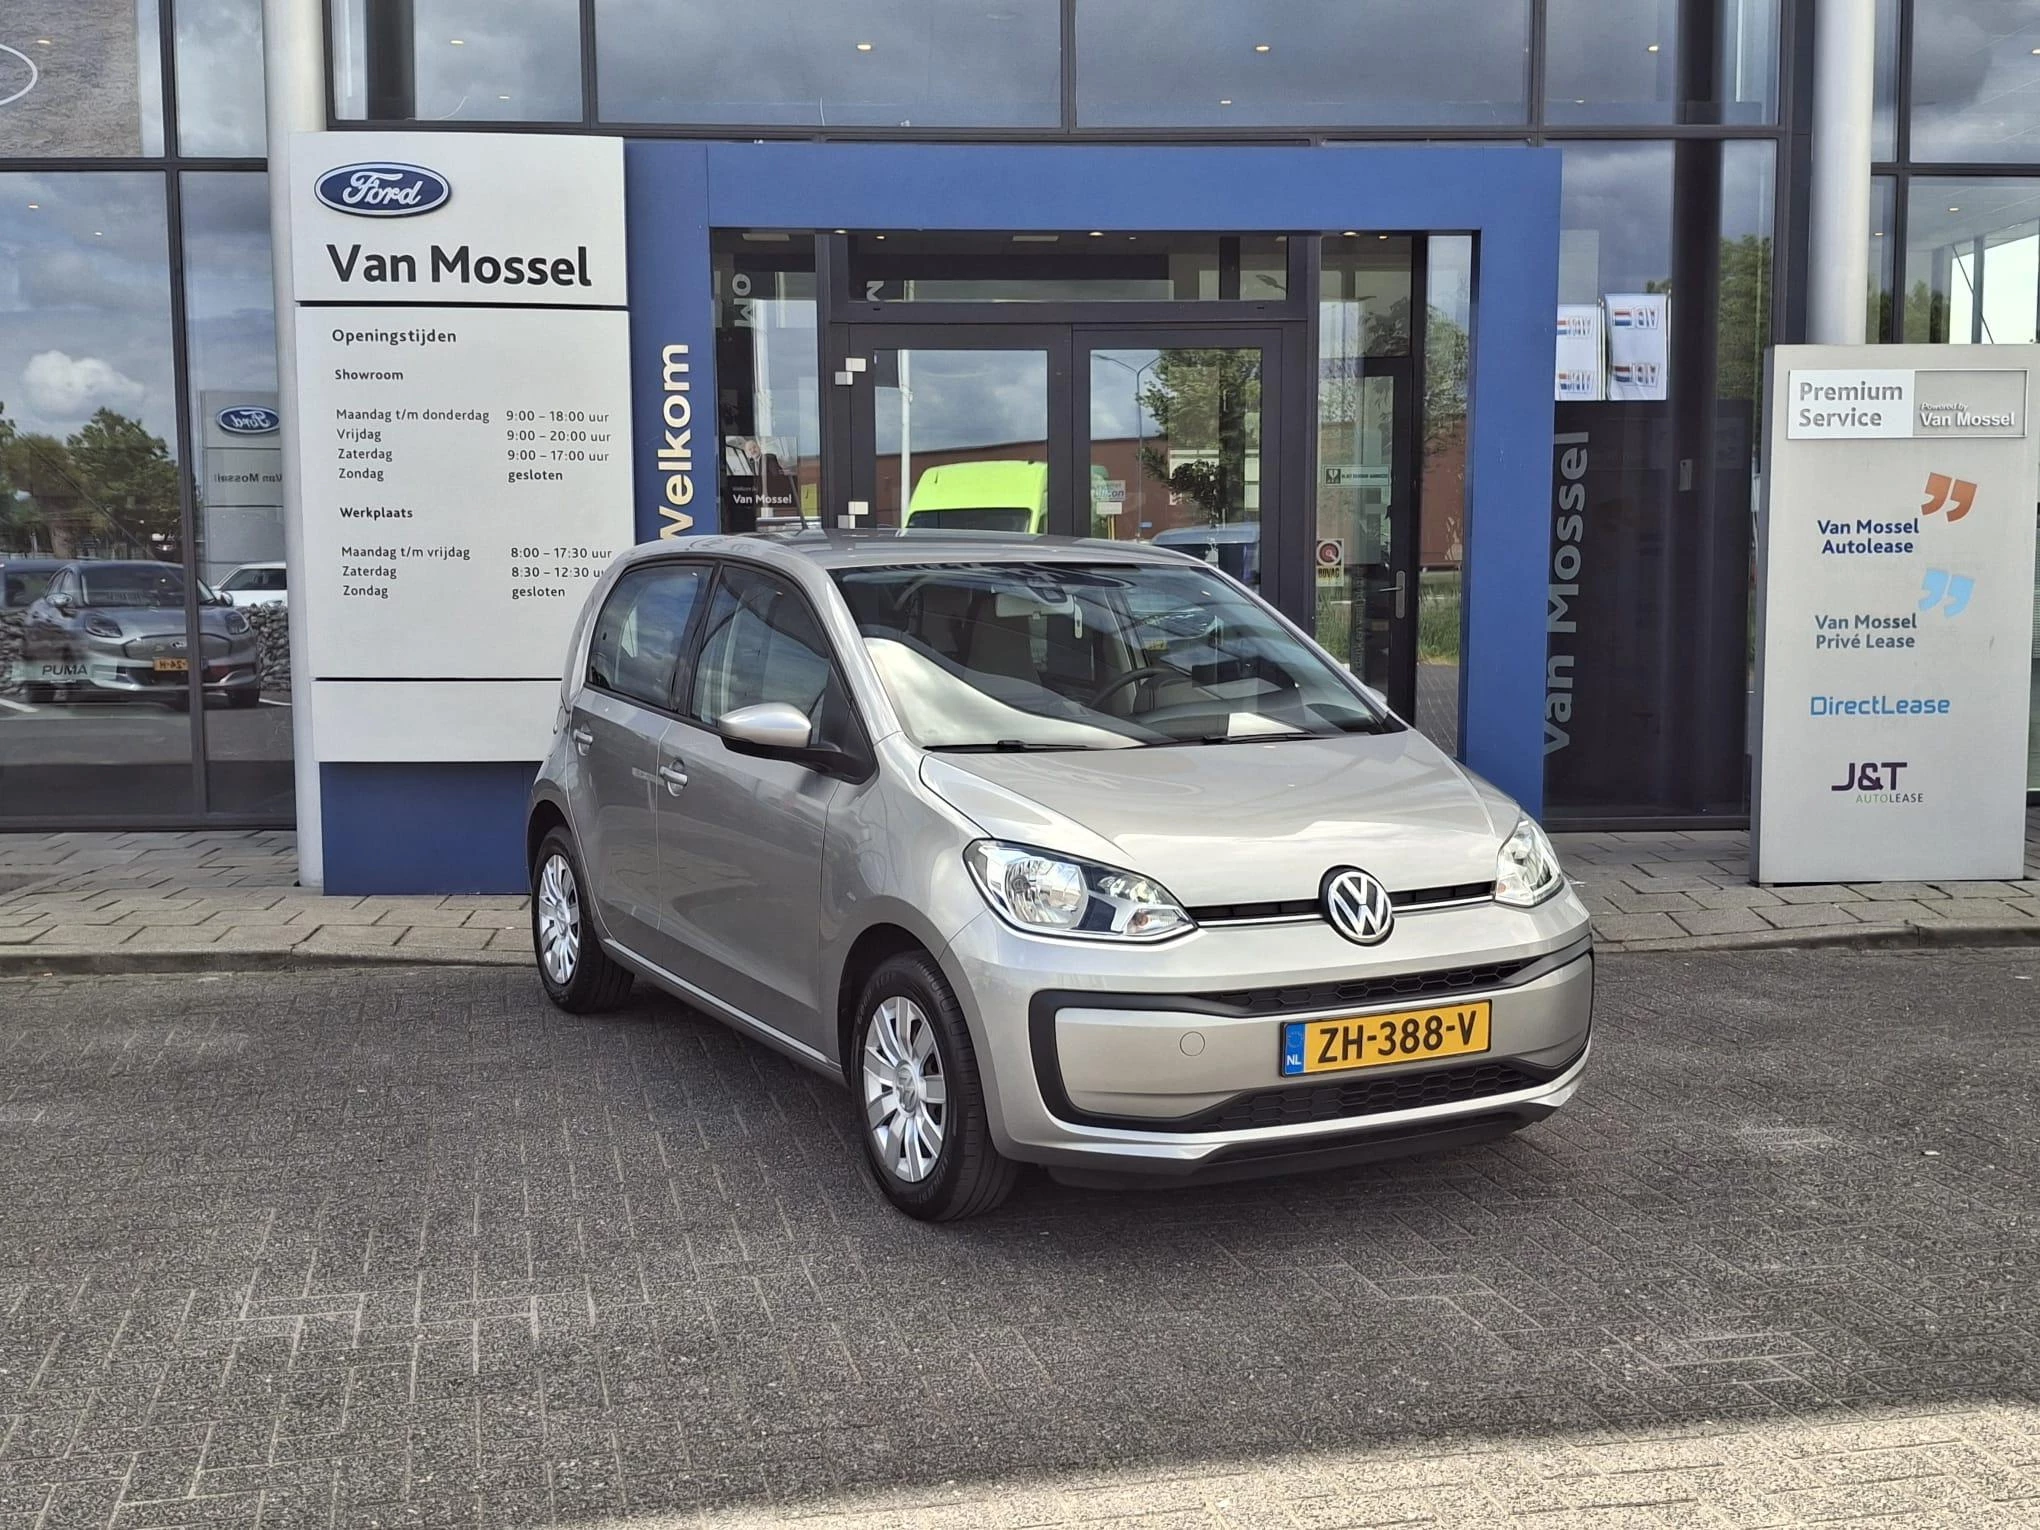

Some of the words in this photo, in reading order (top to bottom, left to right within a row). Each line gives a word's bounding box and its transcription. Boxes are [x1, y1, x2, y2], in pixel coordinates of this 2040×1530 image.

[342, 171, 423, 207] Ford
[327, 244, 416, 282] Van
[431, 246, 591, 286] Mossel
[332, 328, 457, 346] Openingstijden
[334, 368, 404, 380] Showroom
[1800, 380, 1903, 401] Premium
[336, 408, 392, 423] Maandag
[395, 408, 419, 421] t/m
[422, 408, 490, 424] donderdag
[506, 410, 535, 422] 9:00
[549, 410, 585, 422] 18:00
[588, 414, 610, 423] uur
[1798, 406, 1882, 427] Service
[1919, 411, 1952, 428] Van
[1955, 410, 2016, 428] Mossel
[336, 427, 382, 443] Vrijdag
[506, 429, 536, 441] 9:00
[550, 430, 587, 442] 20:00
[590, 433, 611, 442] uur
[337, 447, 393, 463] Zaterdag
[507, 449, 536, 461] 9:00
[550, 450, 585, 462] 17:00
[588, 453, 609, 462] uur
[338, 467, 385, 482] Zondag
[508, 468, 563, 484] gesloten
[732, 494, 753, 504] Van
[754, 493, 793, 505] Mossel
[339, 506, 413, 521] Werkplaats
[1546, 431, 1590, 634] Mossel
[1817, 519, 1851, 535] Van
[1856, 517, 1920, 535] Mossel
[341, 546, 397, 561] Maandag
[400, 546, 424, 558] t/m
[427, 546, 471, 561] vrijdag
[510, 547, 540, 558] 8:00
[553, 547, 588, 559] 17:30
[591, 550, 612, 559] uur
[1821, 537, 1914, 554] Autolease
[342, 565, 397, 580] Zaterdag
[511, 566, 540, 578] 8:30
[554, 566, 590, 578] 12:30
[343, 584, 389, 600] Zondag
[511, 585, 566, 600] gesloten
[1814, 614, 1849, 630] Van
[1854, 612, 1917, 629] Mossel
[1816, 633, 1861, 649] Privé
[1866, 633, 1916, 649] Lease
[42, 665, 88, 676] PUMA
[1541, 653, 1574, 756] Van
[1810, 695, 1951, 716] DirectLease
[1831, 761, 1908, 792] J&T
[1855, 793, 1924, 803] AUTOLEASE
[1318, 1010, 1476, 1064] ZH-388-V
[1286, 1055, 1301, 1065] NL
